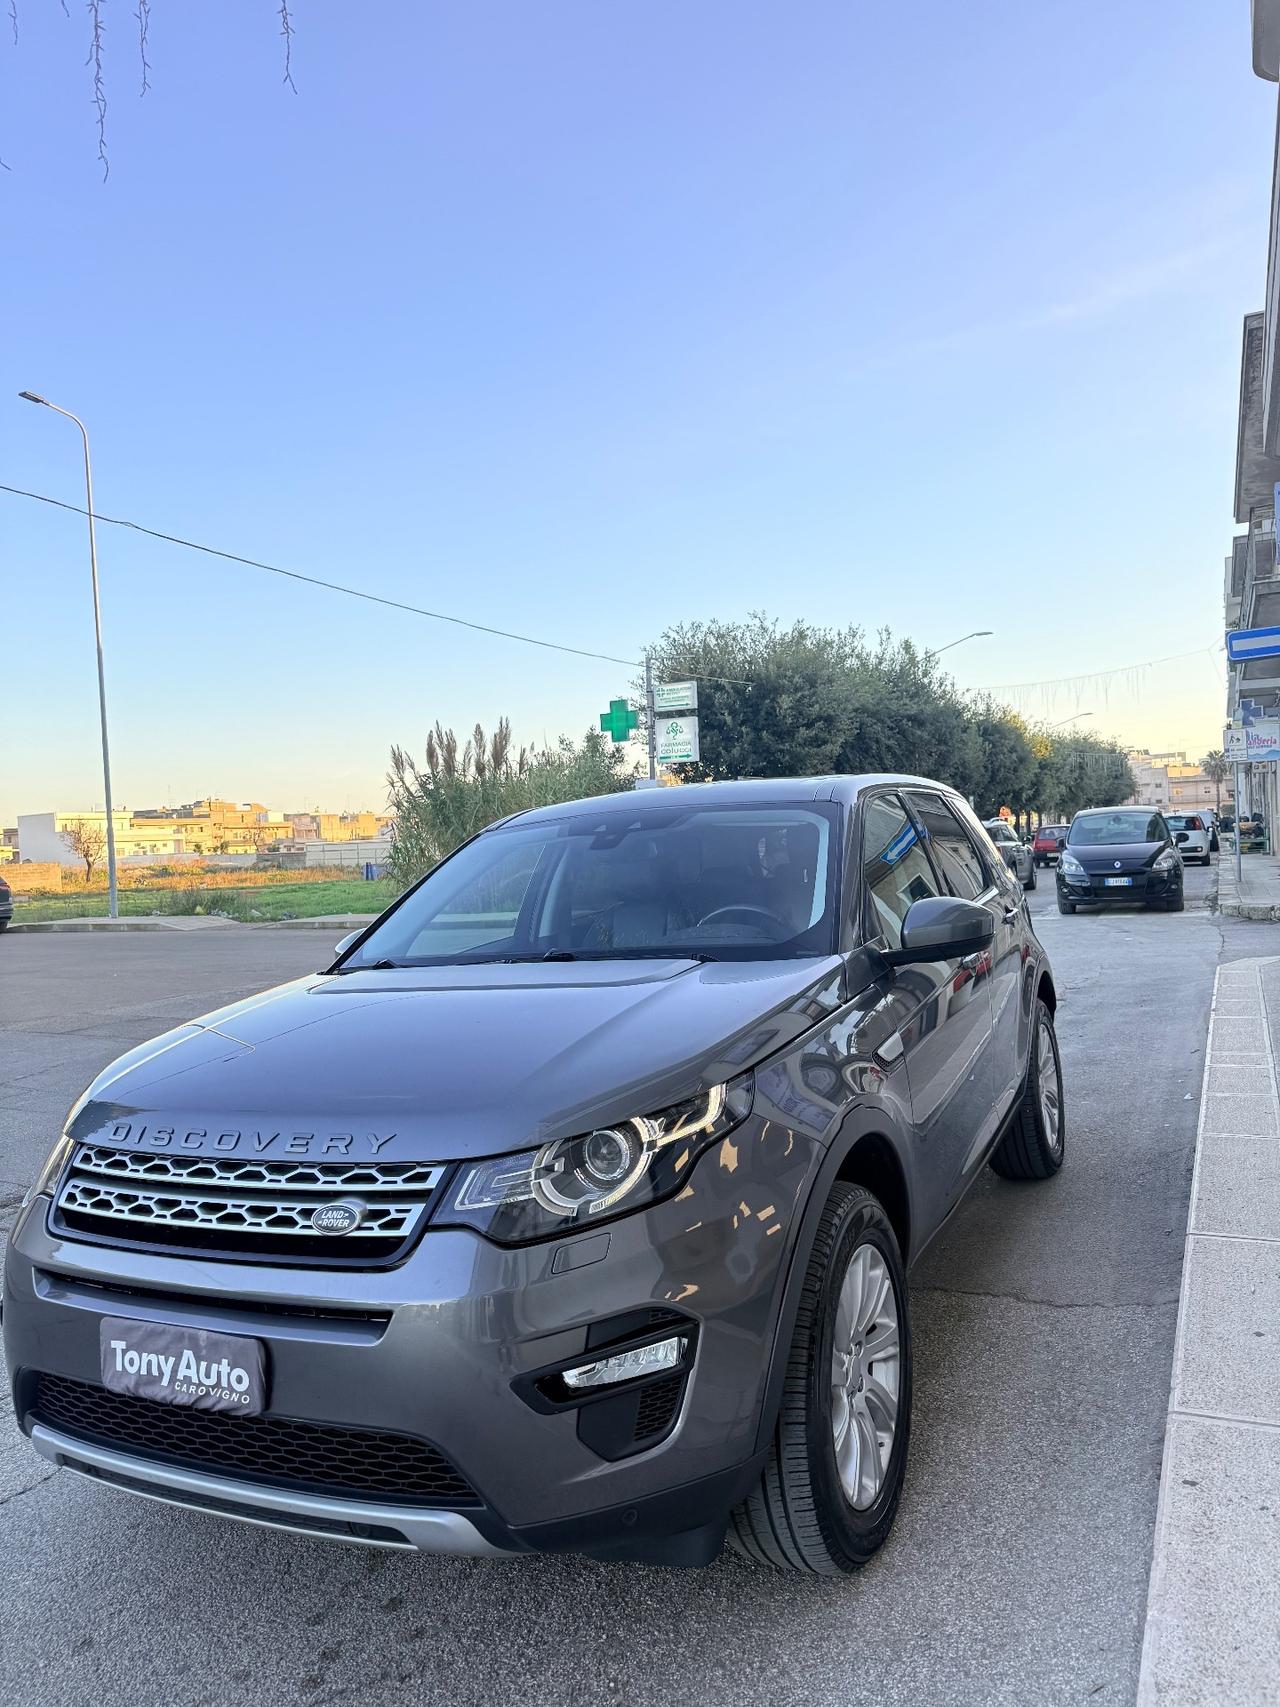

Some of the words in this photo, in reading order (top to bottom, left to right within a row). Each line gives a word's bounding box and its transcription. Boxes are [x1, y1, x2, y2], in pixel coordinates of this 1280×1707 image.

[108, 1123, 397, 1154] DISCOVERY
[321, 1219, 350, 1228] ROVER
[174, 1381, 250, 1404] CAROVIGNO
